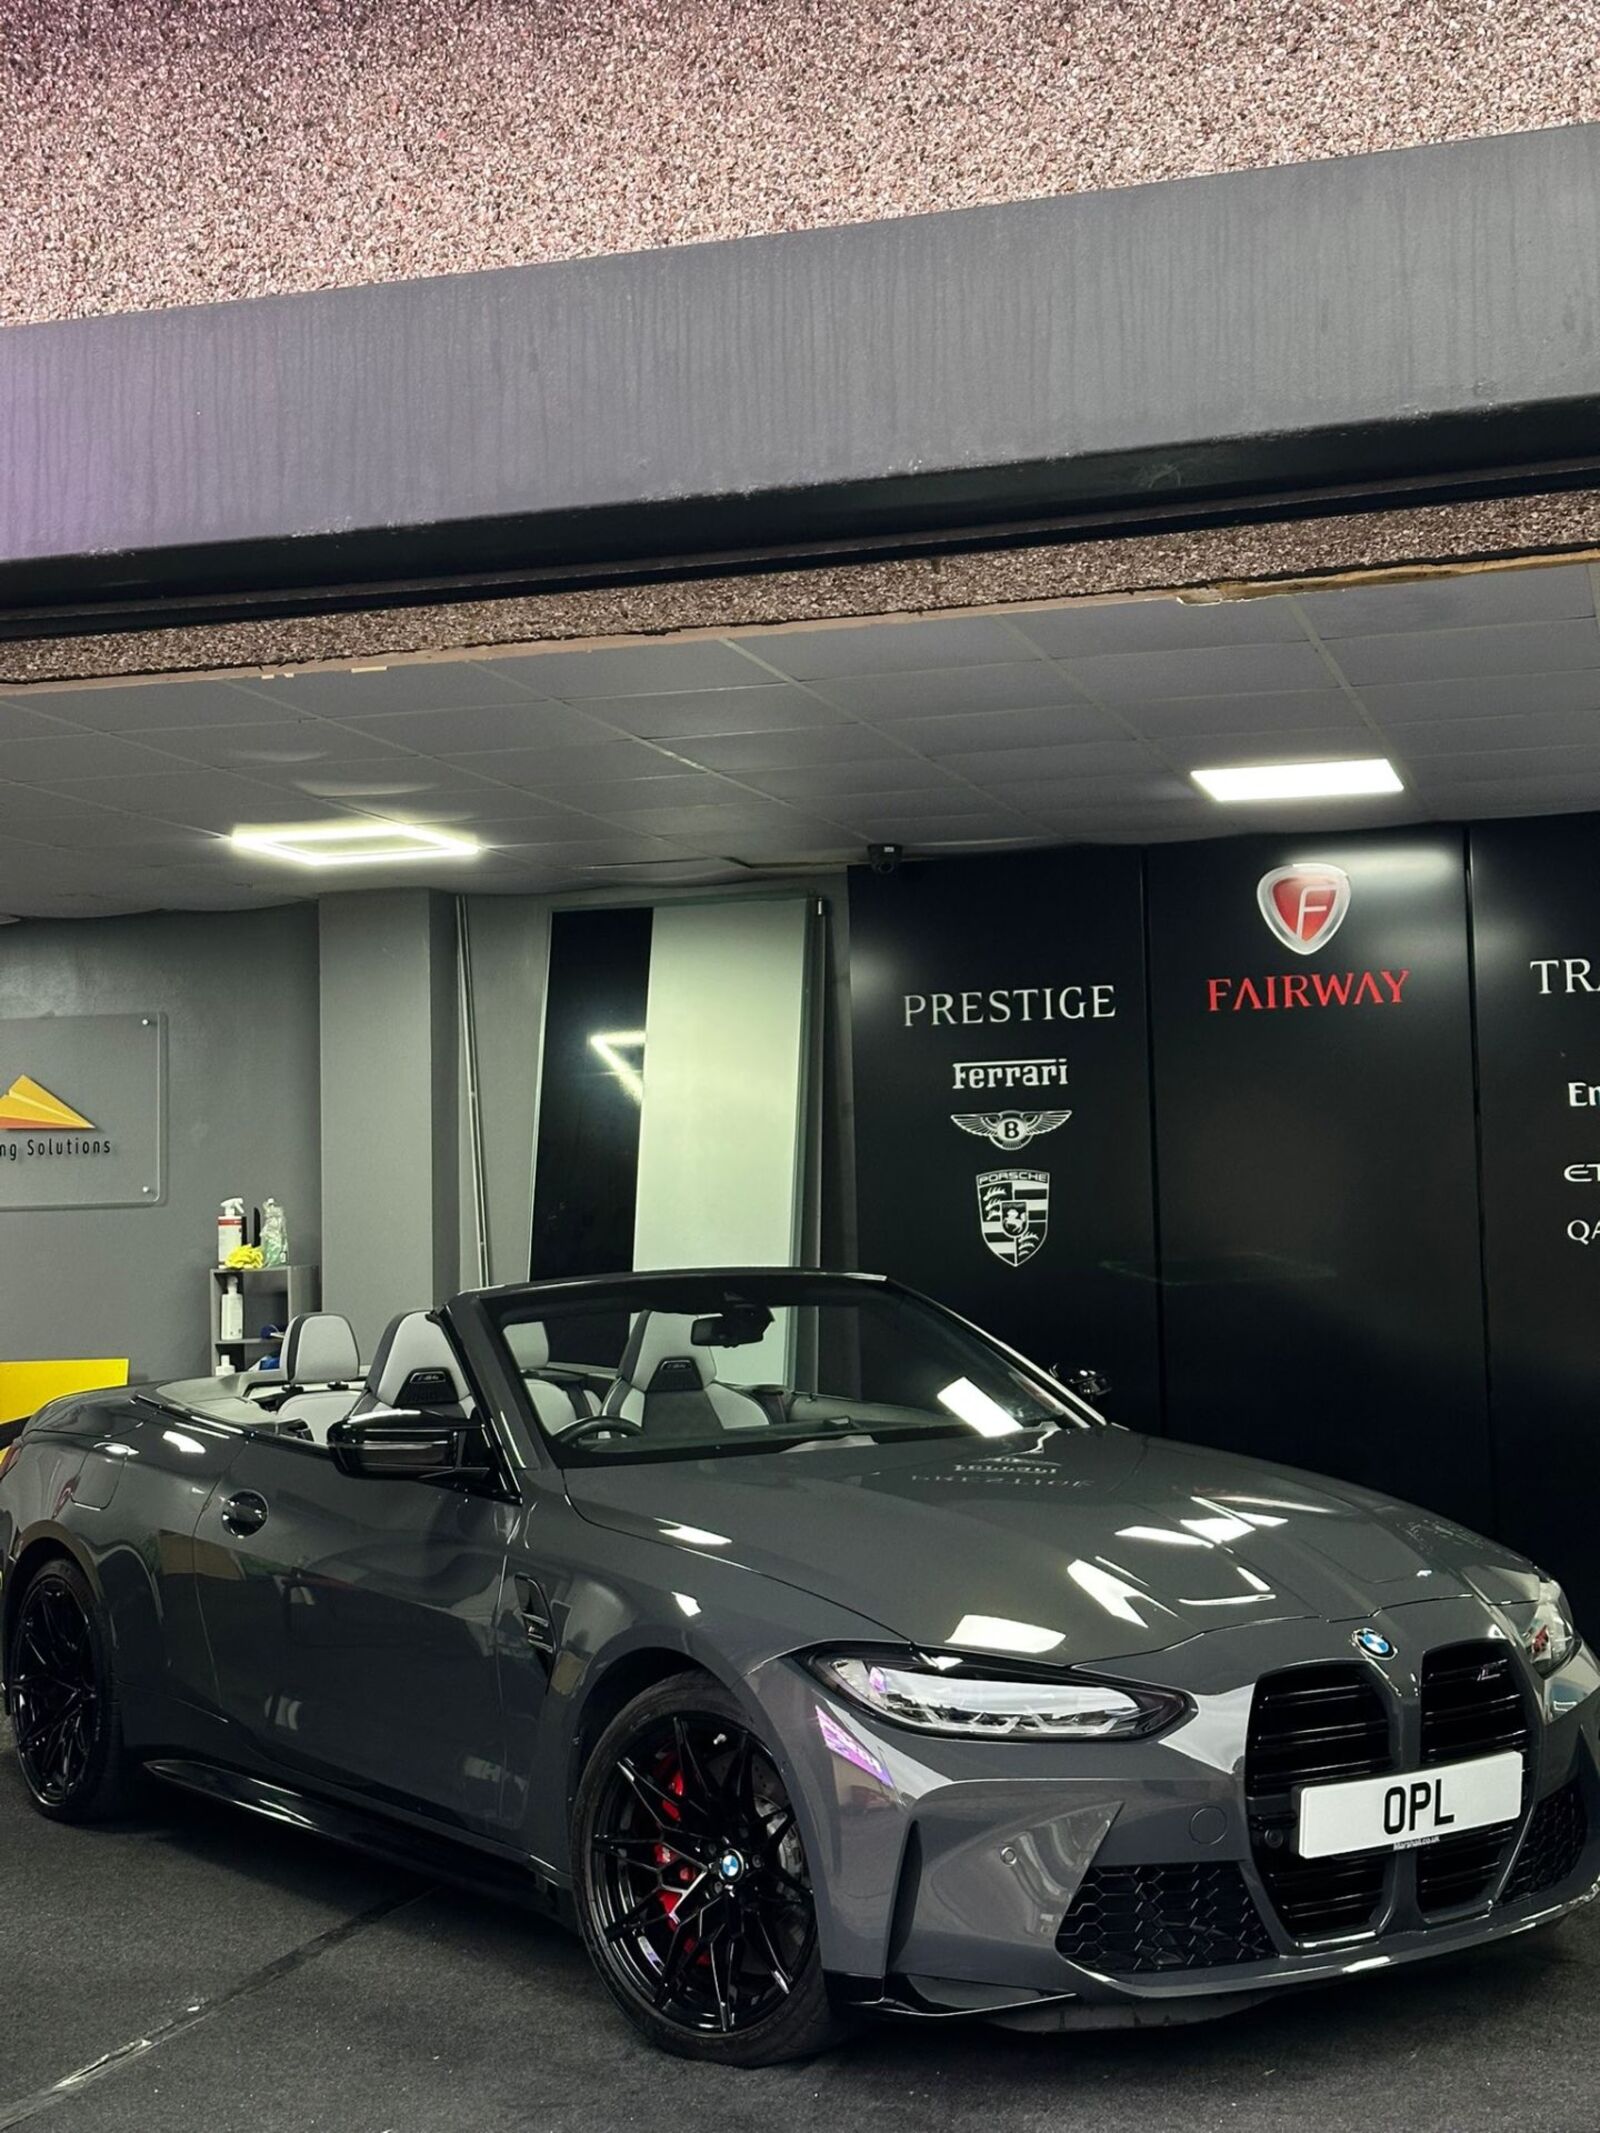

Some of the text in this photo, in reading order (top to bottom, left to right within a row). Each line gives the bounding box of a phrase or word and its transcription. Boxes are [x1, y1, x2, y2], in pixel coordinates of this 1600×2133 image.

[1208, 969, 1410, 1012] FAIRWAY
[1529, 958, 1600, 994] TR
[904, 984, 1116, 1026] PRESTIGE
[952, 1058, 1068, 1089] Ferrari
[27, 1137, 111, 1156] Solutions
[979, 1171, 1047, 1185] PORSCHE
[1384, 1778, 1455, 1835] OPL
